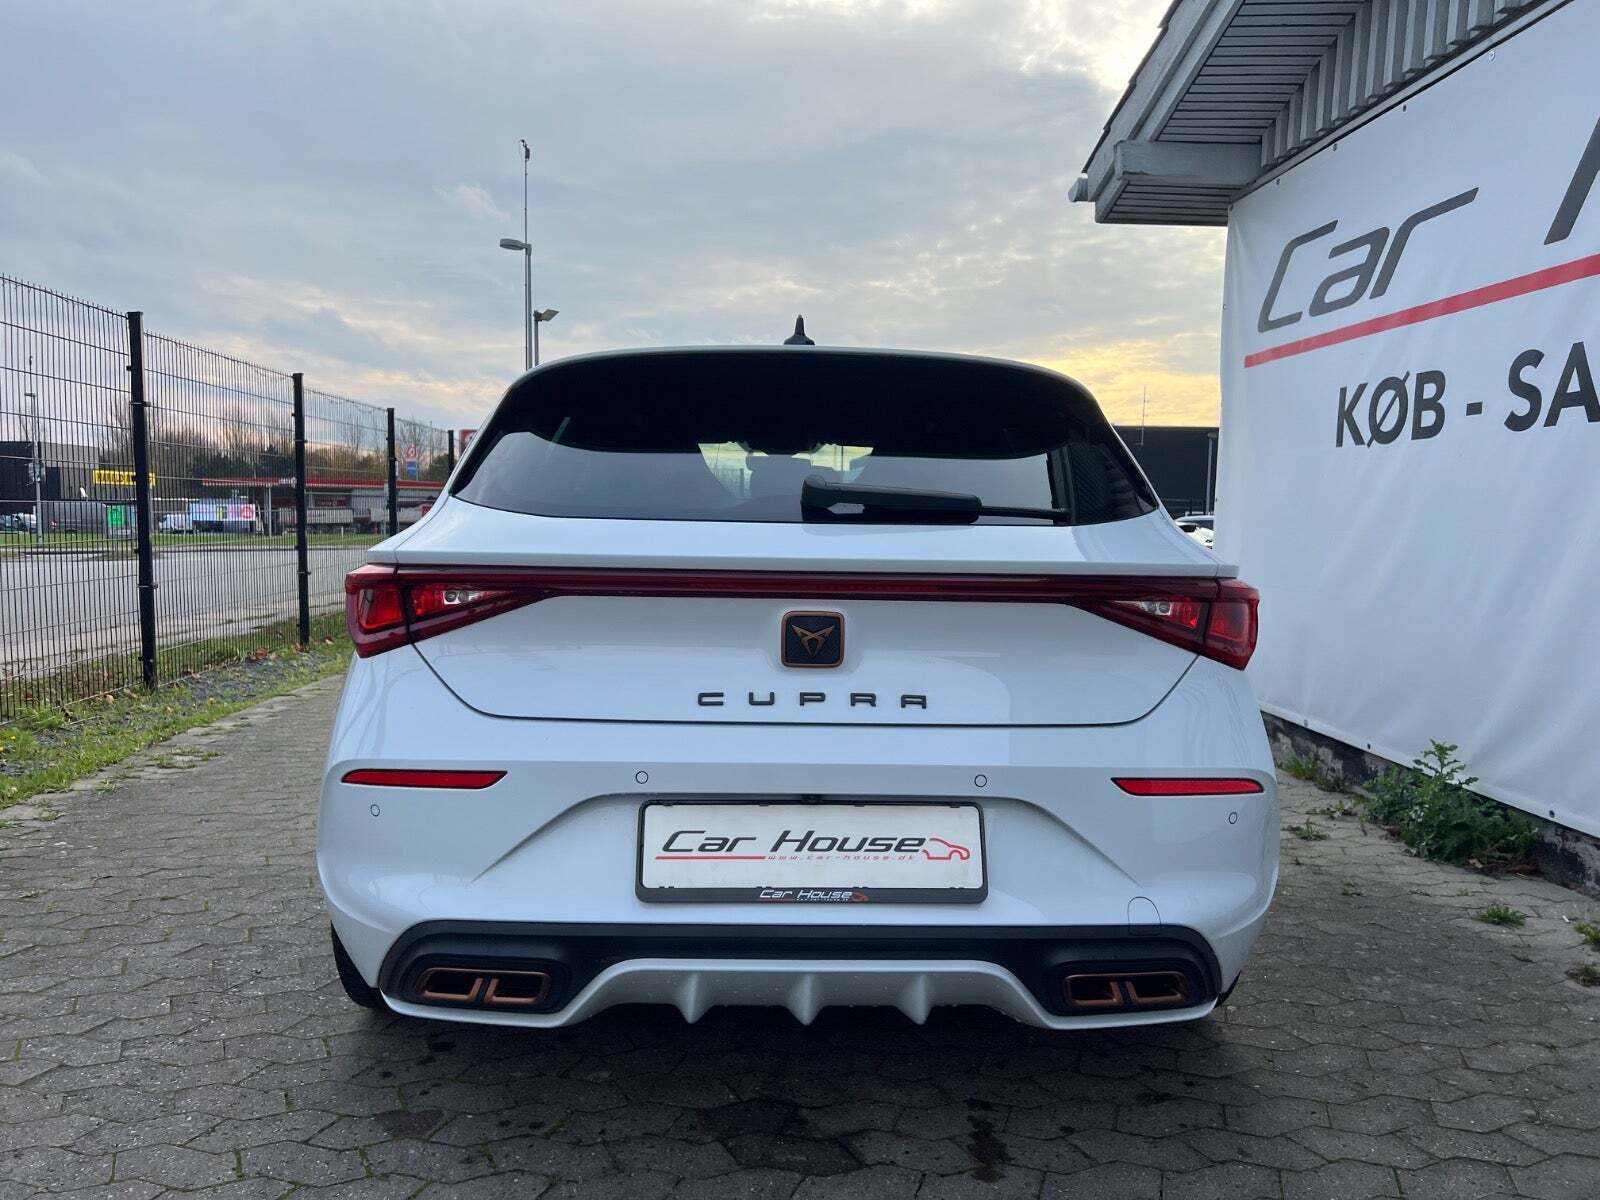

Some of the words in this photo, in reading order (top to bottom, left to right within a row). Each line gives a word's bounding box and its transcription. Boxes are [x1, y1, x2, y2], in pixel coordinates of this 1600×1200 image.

[1258, 187, 1480, 333] Car
[1335, 370, 1446, 448] KØB
[697, 691, 927, 709] CUPRA
[661, 830, 757, 853] Car
[769, 830, 926, 853] House
[759, 889, 793, 898] Car
[796, 889, 853, 899] House
